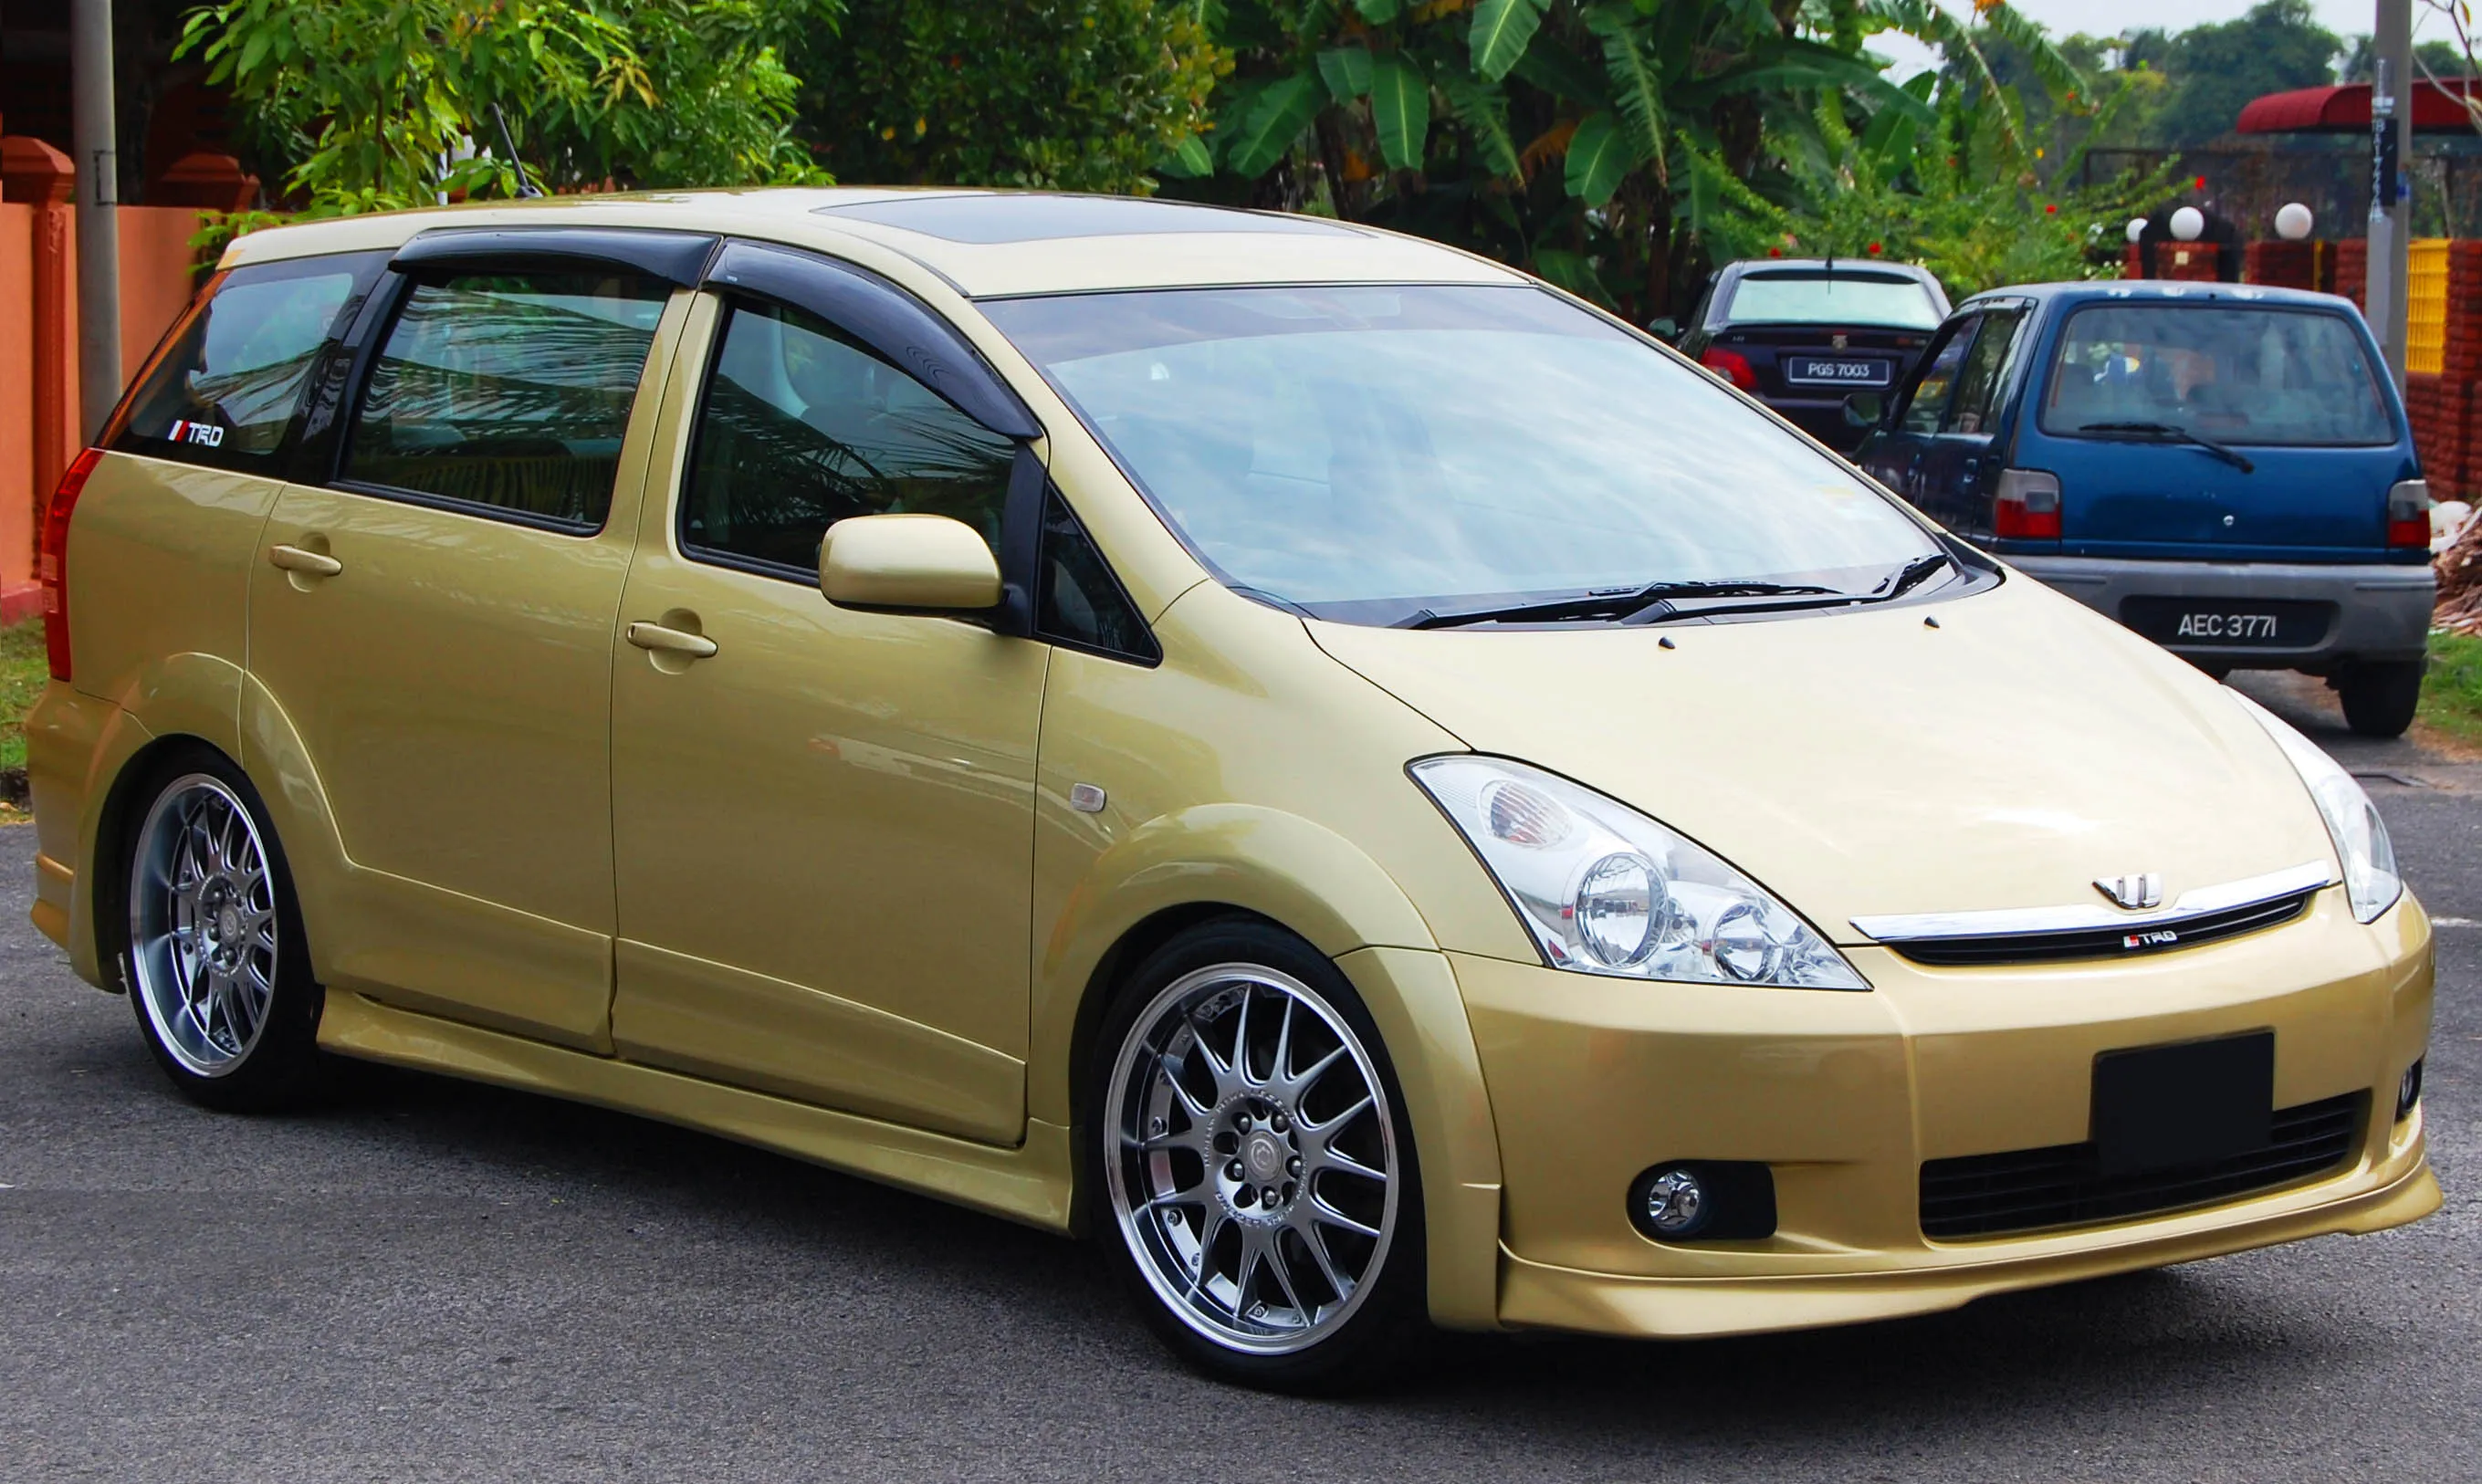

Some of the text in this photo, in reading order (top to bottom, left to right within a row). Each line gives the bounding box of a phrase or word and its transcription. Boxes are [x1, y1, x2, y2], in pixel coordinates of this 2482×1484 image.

[1807, 362, 1869, 377] PGS 7003
[188, 421, 225, 447] TRD
[2177, 613, 2277, 637] AEC 3771
[2138, 930, 2178, 945] TRD
